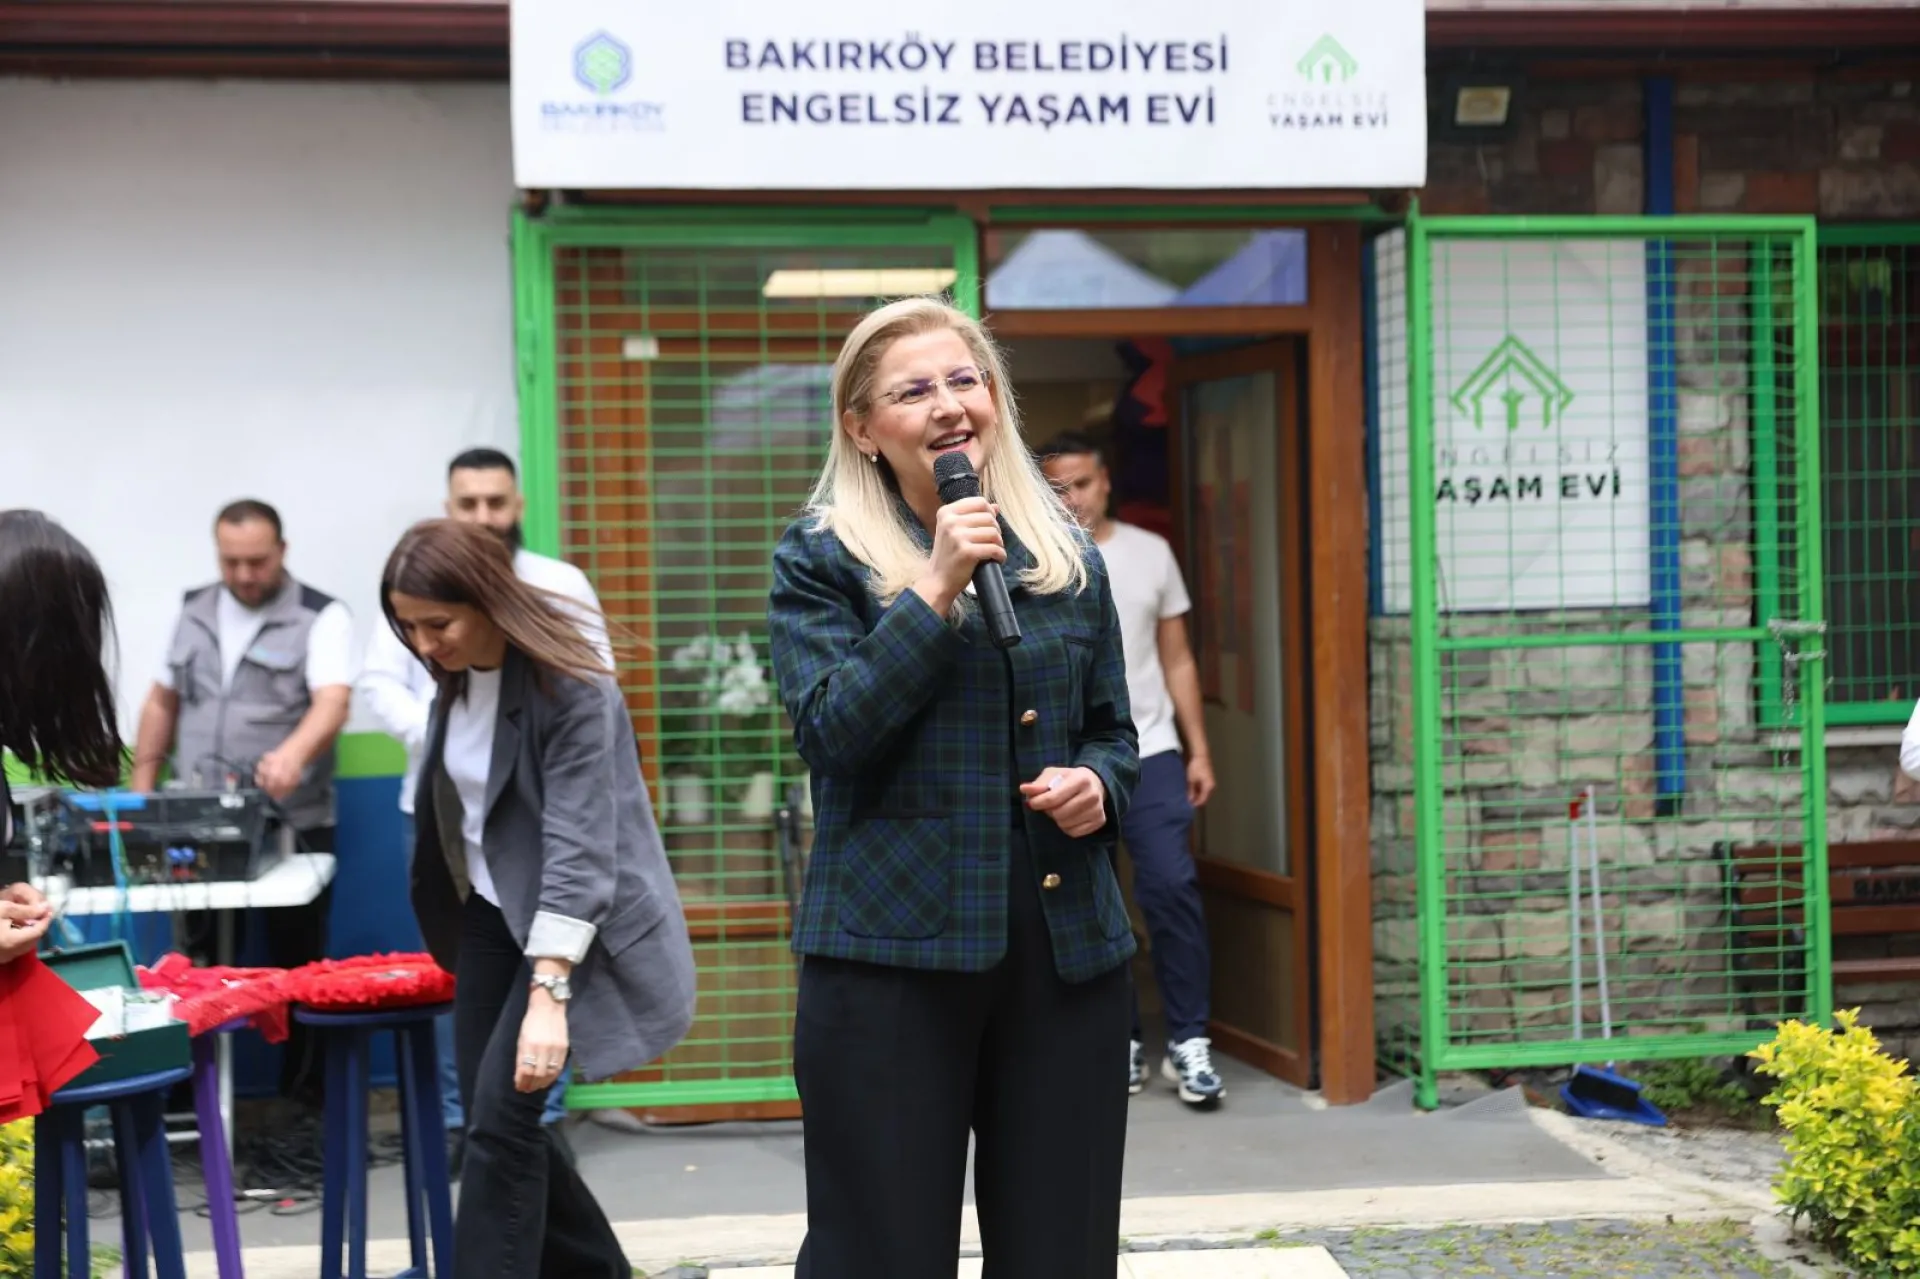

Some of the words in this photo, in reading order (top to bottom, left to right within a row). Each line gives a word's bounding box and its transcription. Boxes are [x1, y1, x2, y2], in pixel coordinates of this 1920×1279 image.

[725, 32, 956, 71] BAKIRKÖY
[974, 33, 1228, 72] BELEDİYESİ
[741, 86, 961, 124] ENGELSİZ
[978, 94, 1129, 130] YAŞAM
[1146, 86, 1215, 125] EVİ
[1436, 474, 1543, 506] AŞAM
[1561, 468, 1621, 499] EVİ
